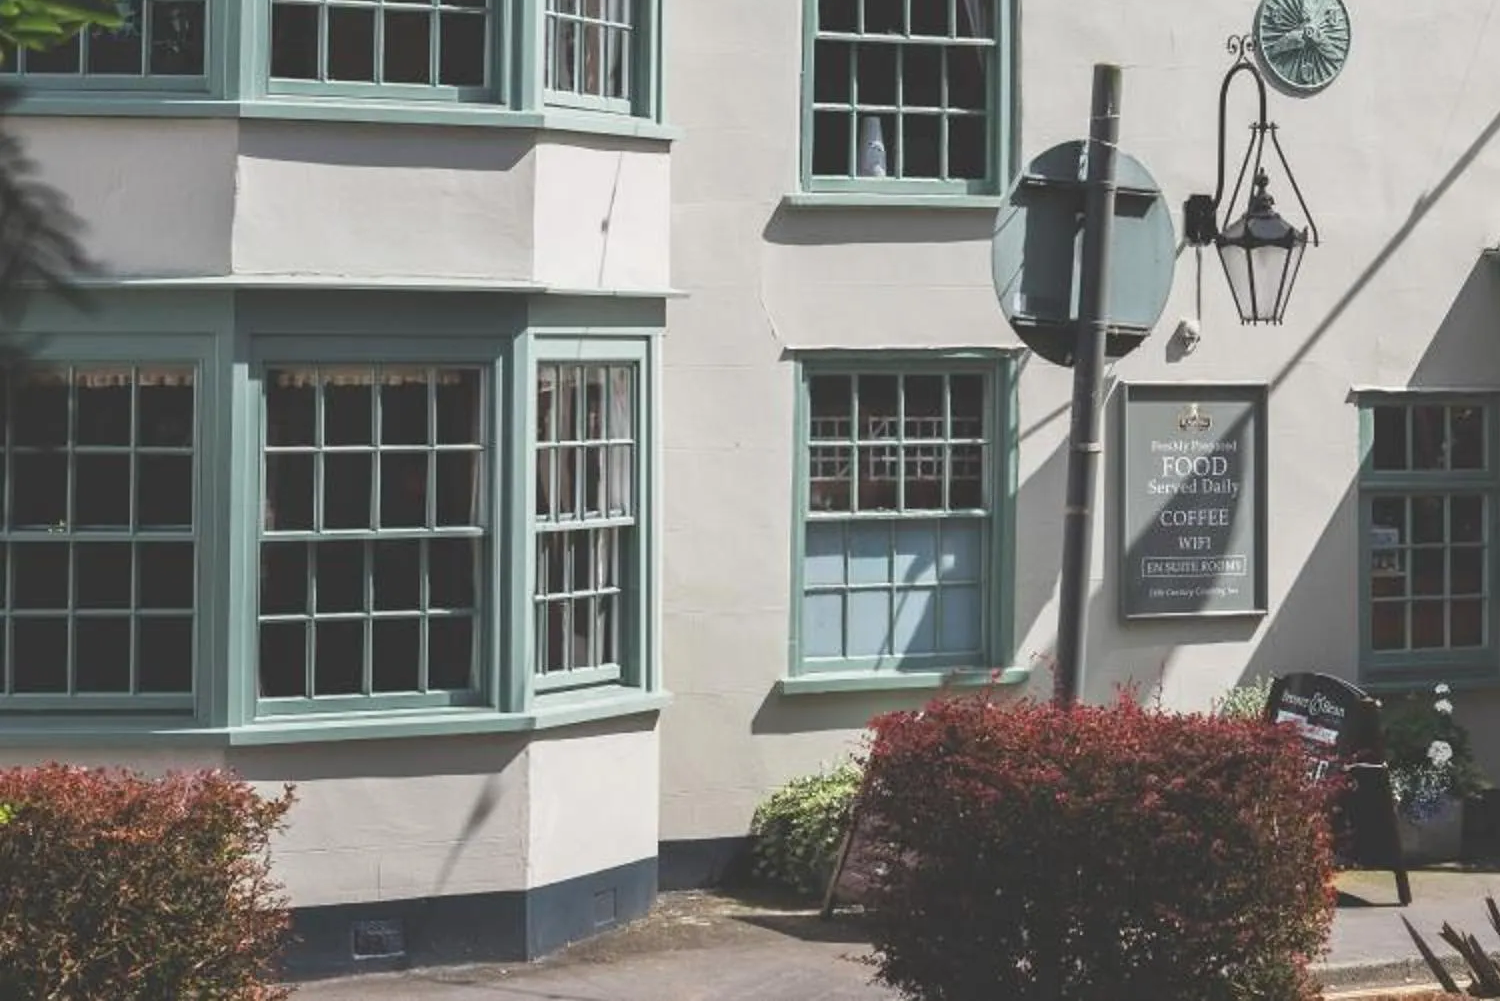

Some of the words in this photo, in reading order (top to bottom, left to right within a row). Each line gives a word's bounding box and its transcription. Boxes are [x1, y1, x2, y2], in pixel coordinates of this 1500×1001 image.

[1161, 456, 1228, 477] FOOD
[1147, 479, 1197, 495] Served
[1202, 478, 1239, 499] Daily
[1161, 508, 1229, 527] COFFEE
